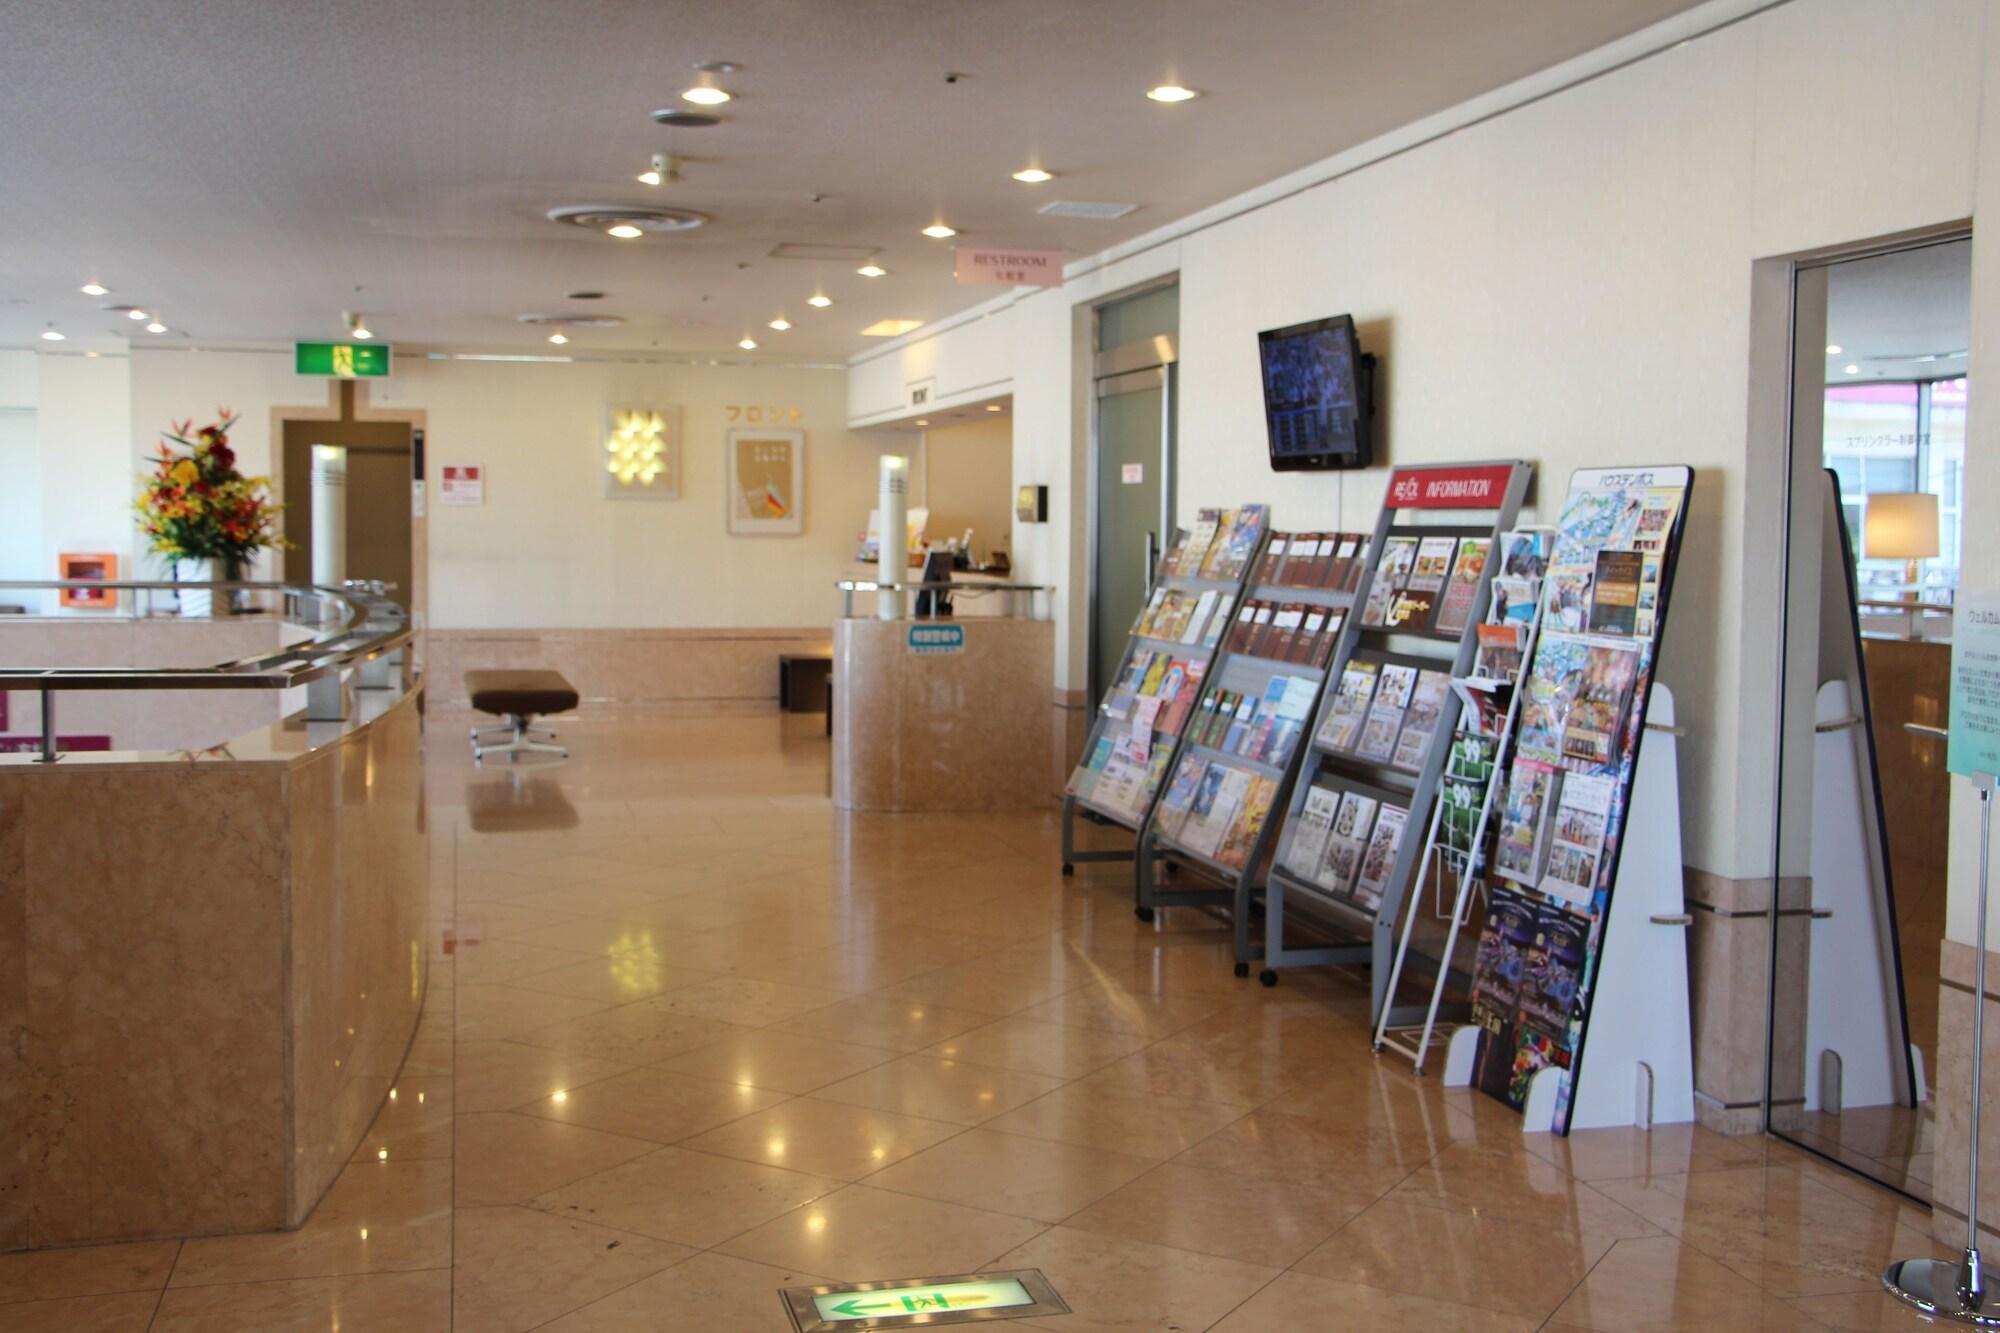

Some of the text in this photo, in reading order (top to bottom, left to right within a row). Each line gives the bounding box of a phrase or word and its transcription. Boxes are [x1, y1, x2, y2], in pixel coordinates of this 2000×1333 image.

[974, 254, 1047, 266] RESTROOM
[726, 405, 802, 424] フロント
[1599, 473, 1655, 487] ハウステンボス
[1426, 479, 1492, 498] INFORMATION
